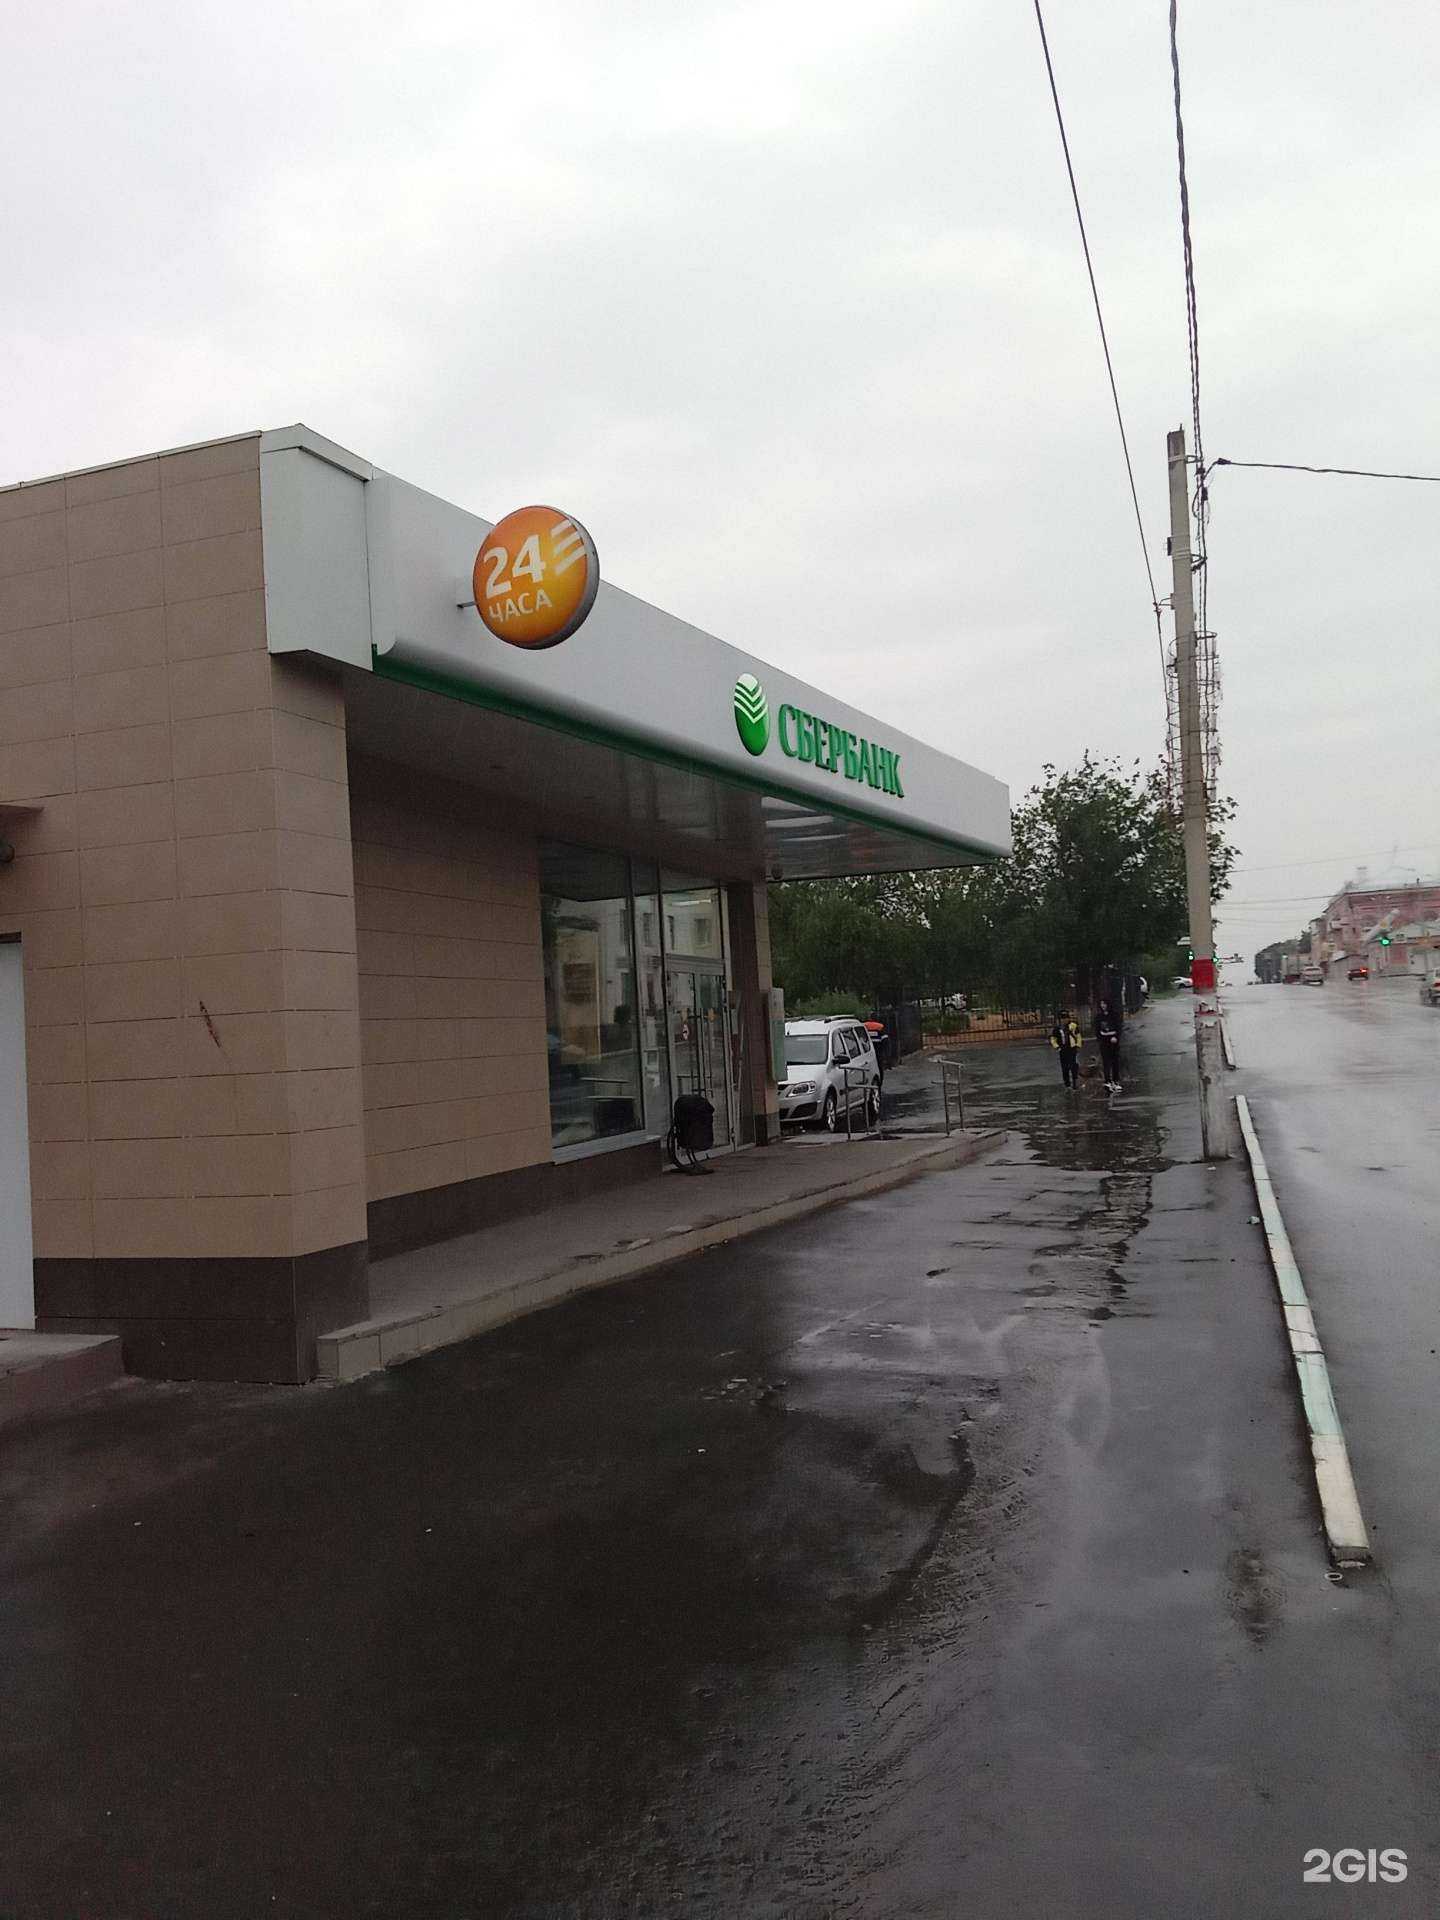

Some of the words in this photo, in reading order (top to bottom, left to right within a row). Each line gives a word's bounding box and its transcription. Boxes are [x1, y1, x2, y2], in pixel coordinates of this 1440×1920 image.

[483, 534, 546, 599] 24
[489, 589, 553, 623] ЧАСА
[778, 704, 904, 798] СБЕРБАНК
